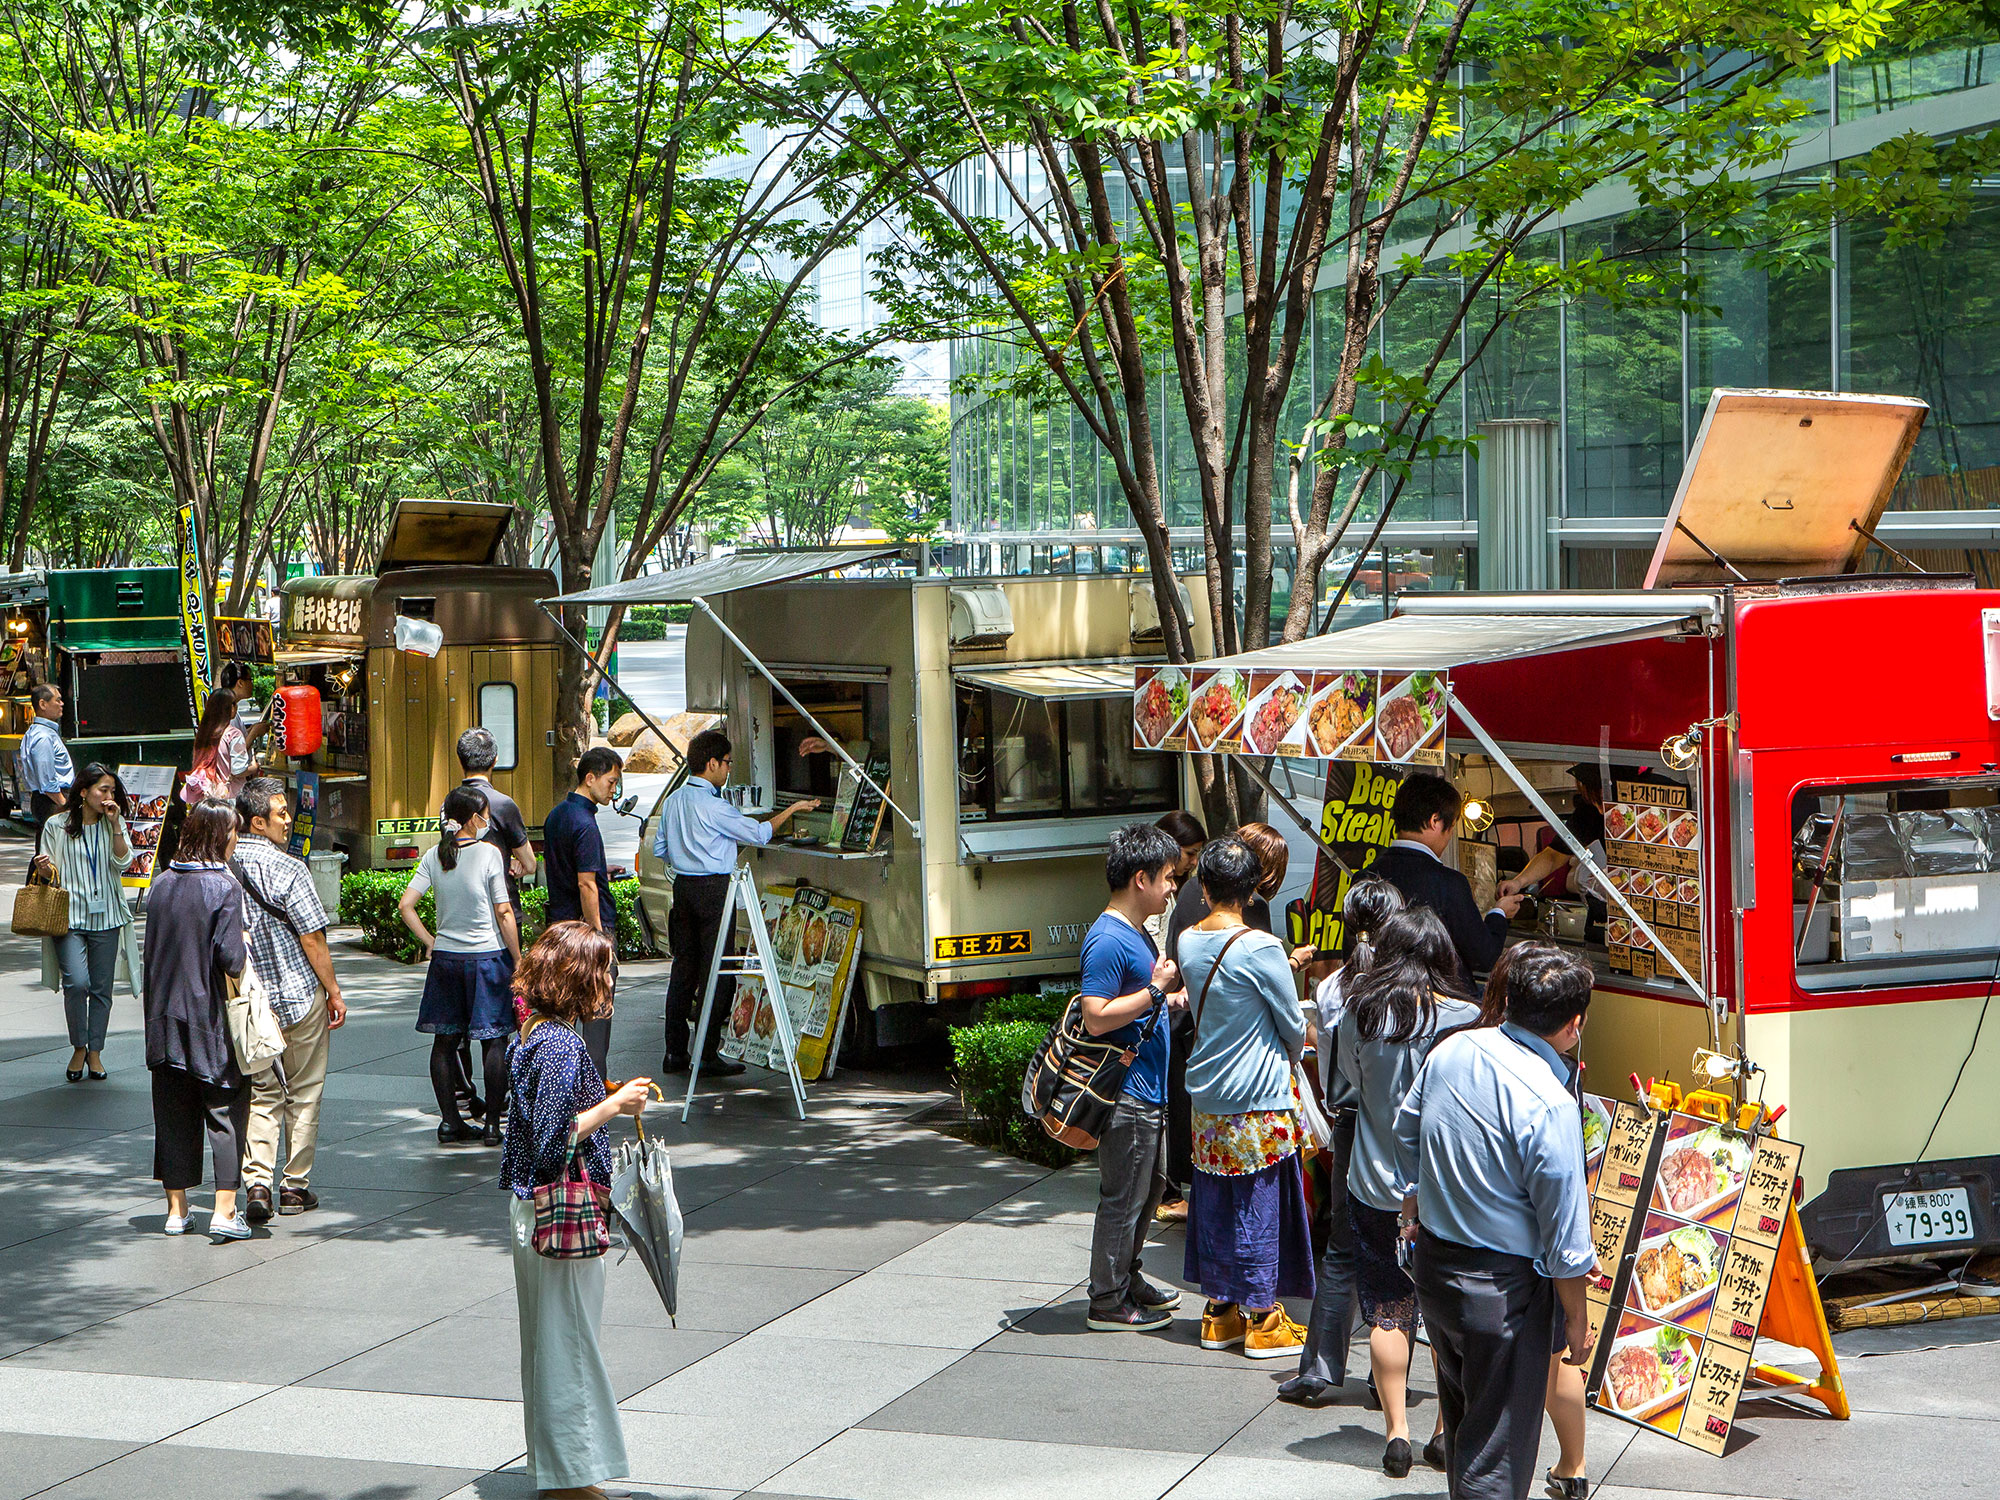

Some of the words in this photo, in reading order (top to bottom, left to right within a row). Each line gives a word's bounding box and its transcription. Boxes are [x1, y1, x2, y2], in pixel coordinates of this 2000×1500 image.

[293, 595, 362, 633] 横手やきそば
[1348, 762, 1404, 810] Bee
[1630, 784, 1686, 807] ビストロカルロス
[380, 820, 440, 833] 高圧ガス
[937, 934, 1026, 957] 高圧ガス
[1615, 1113, 1653, 1139] ビーフステーキ
[1628, 1136, 1645, 1150] ライス
[1757, 1149, 1790, 1171] アボカド
[1620, 1173, 1640, 1188] ¥800
[1750, 1169, 1789, 1197] ビーフステーキ
[1762, 1194, 1781, 1211] ライス
[1905, 1196, 1927, 1209] 練馬
[1929, 1193, 1950, 1208] 800
[1593, 1210, 1626, 1234] ビーフステーキ
[1760, 1215, 1779, 1232] ¥850
[1905, 1209, 1968, 1239] 79-99
[1602, 1231, 1619, 1247] ライス
[1731, 1252, 1764, 1277] アボカド
[1723, 1273, 1762, 1300] ハーブチキン
[1731, 1297, 1754, 1317] ライス
[1732, 1320, 1754, 1337] ¥800
[1700, 1357, 1741, 1390] ビーフステーキ
[1707, 1386, 1730, 1408] ライス
[1706, 1415, 1728, 1435] ¥750
